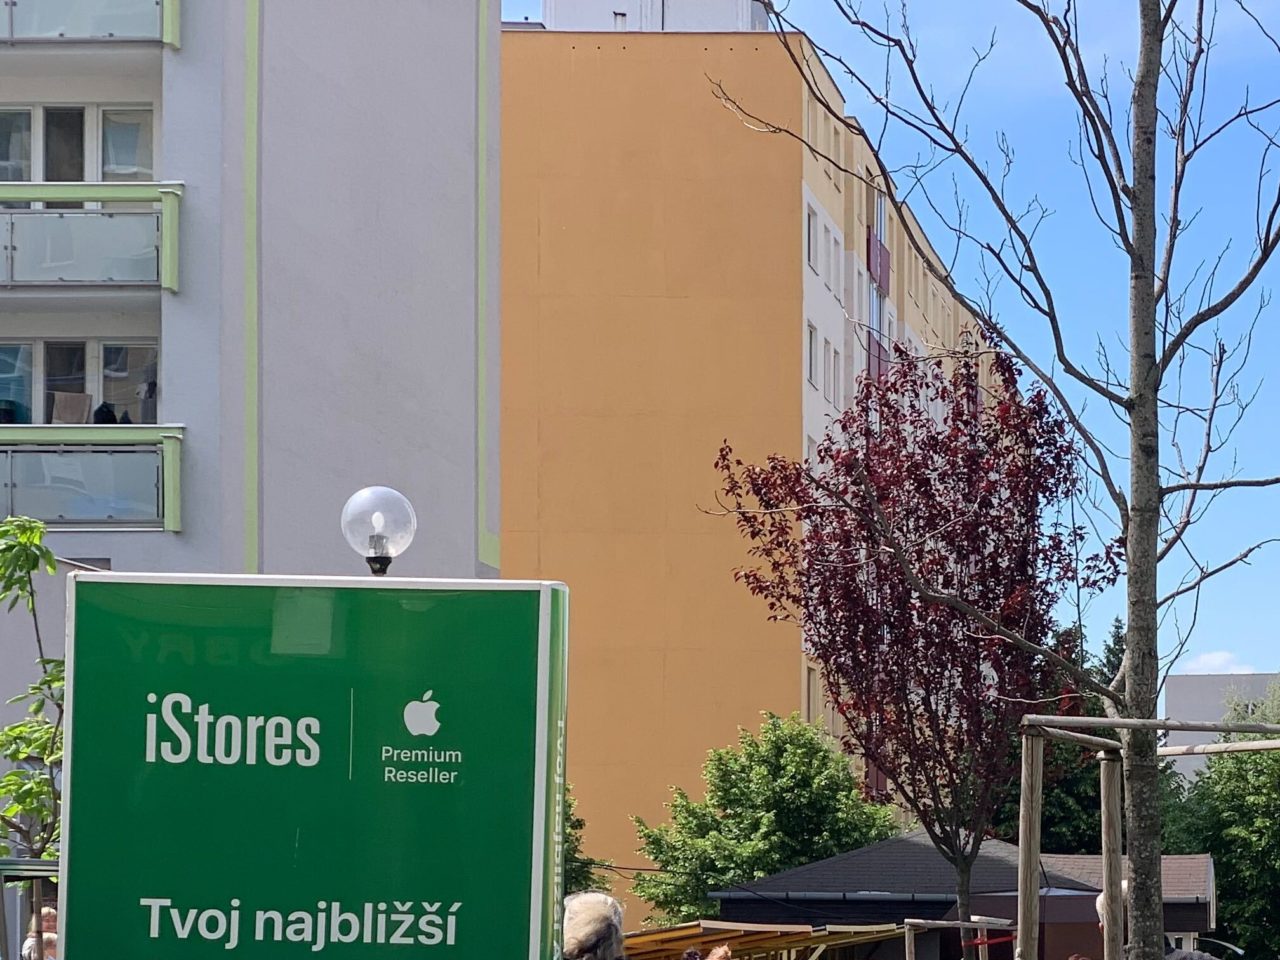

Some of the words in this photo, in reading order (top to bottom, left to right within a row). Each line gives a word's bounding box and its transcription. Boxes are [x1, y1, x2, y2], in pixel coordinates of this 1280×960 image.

[146, 692, 320, 767] iStores
[381, 746, 462, 763] Premium
[384, 766, 458, 784] Reseller
[140, 897, 241, 950] Tvoj
[254, 900, 463, 952] najbližší
